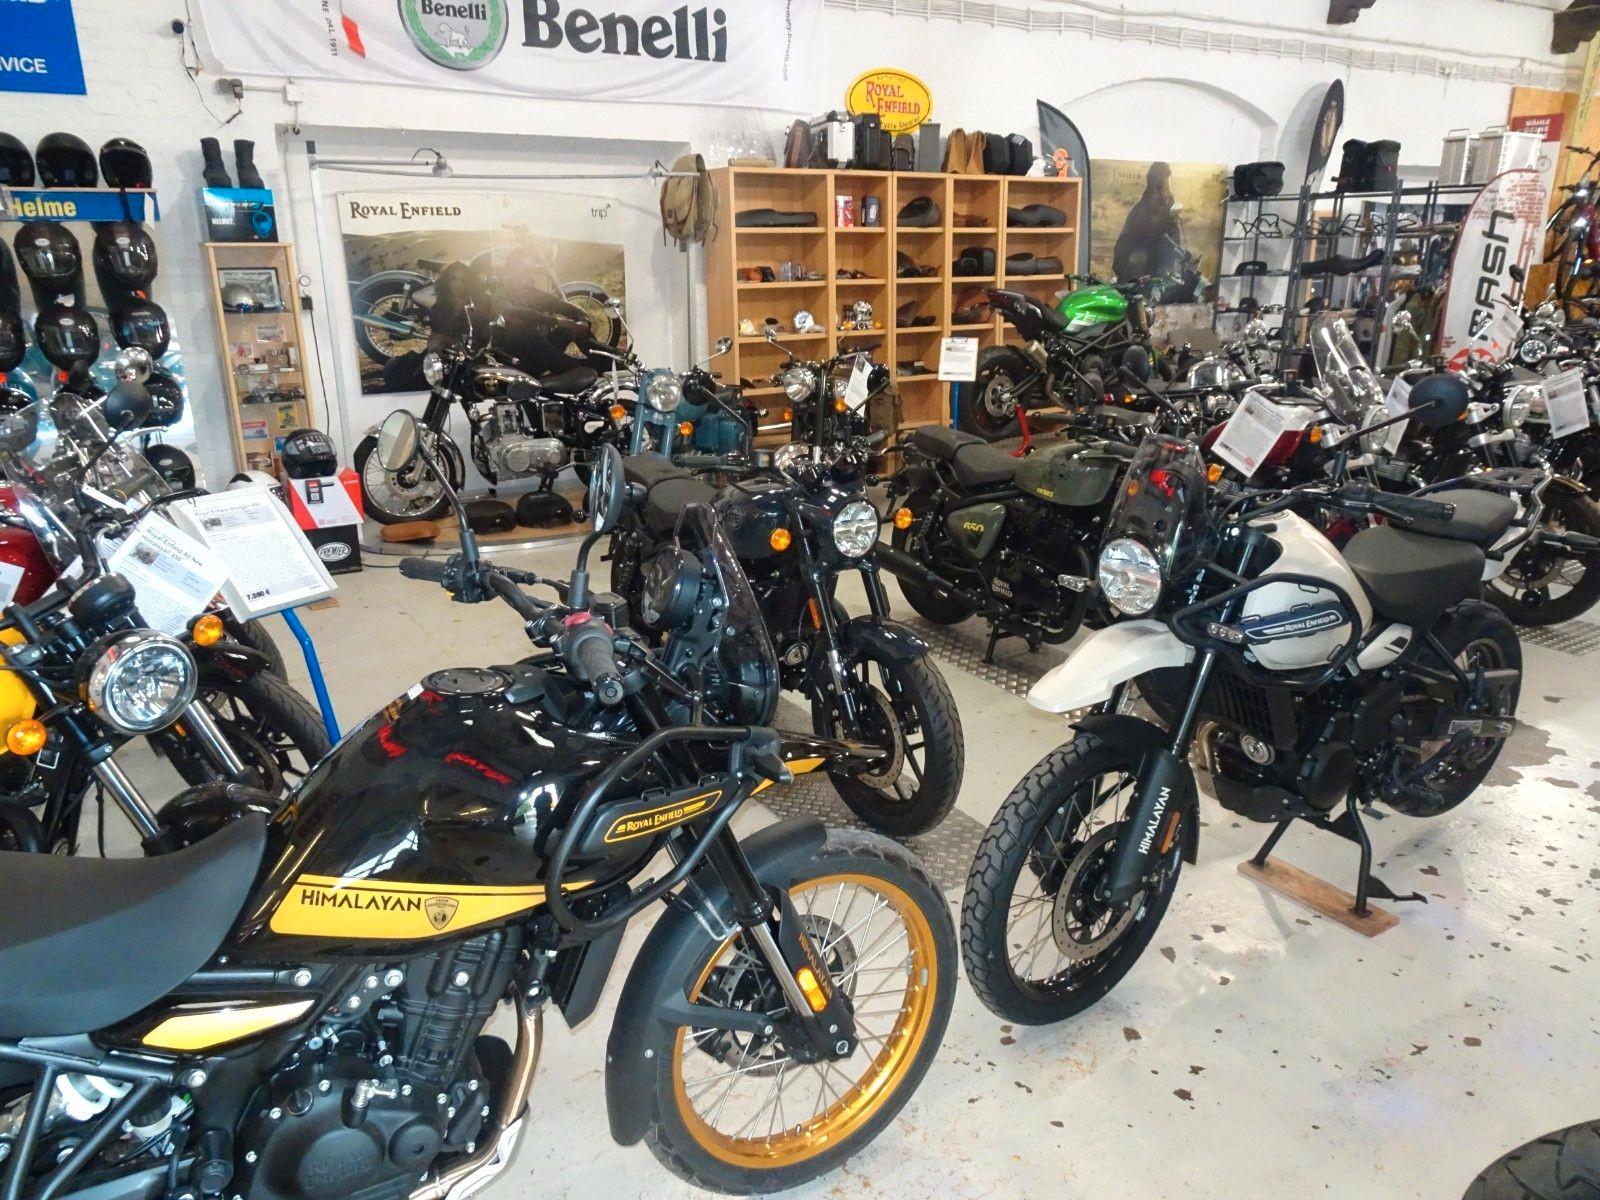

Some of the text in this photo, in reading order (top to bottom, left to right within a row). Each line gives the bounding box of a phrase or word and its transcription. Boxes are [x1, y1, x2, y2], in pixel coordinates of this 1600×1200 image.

[421, 0, 487, 20] Benelli
[521, 0, 727, 62] Benelli
[0, 56, 48, 74] VICE
[866, 81, 904, 108] ROYAL
[877, 98, 921, 117] ENFIELD
[10, 196, 77, 218] Helme
[349, 201, 462, 219] ROYAL ENFIELD
[1285, 616, 1331, 631] ROYAL ENFIELD
[627, 808, 684, 832] ROYAL ENFIELD
[1138, 786, 1171, 854] HIMALAYAN
[300, 889, 421, 912] HIMALAYAN
